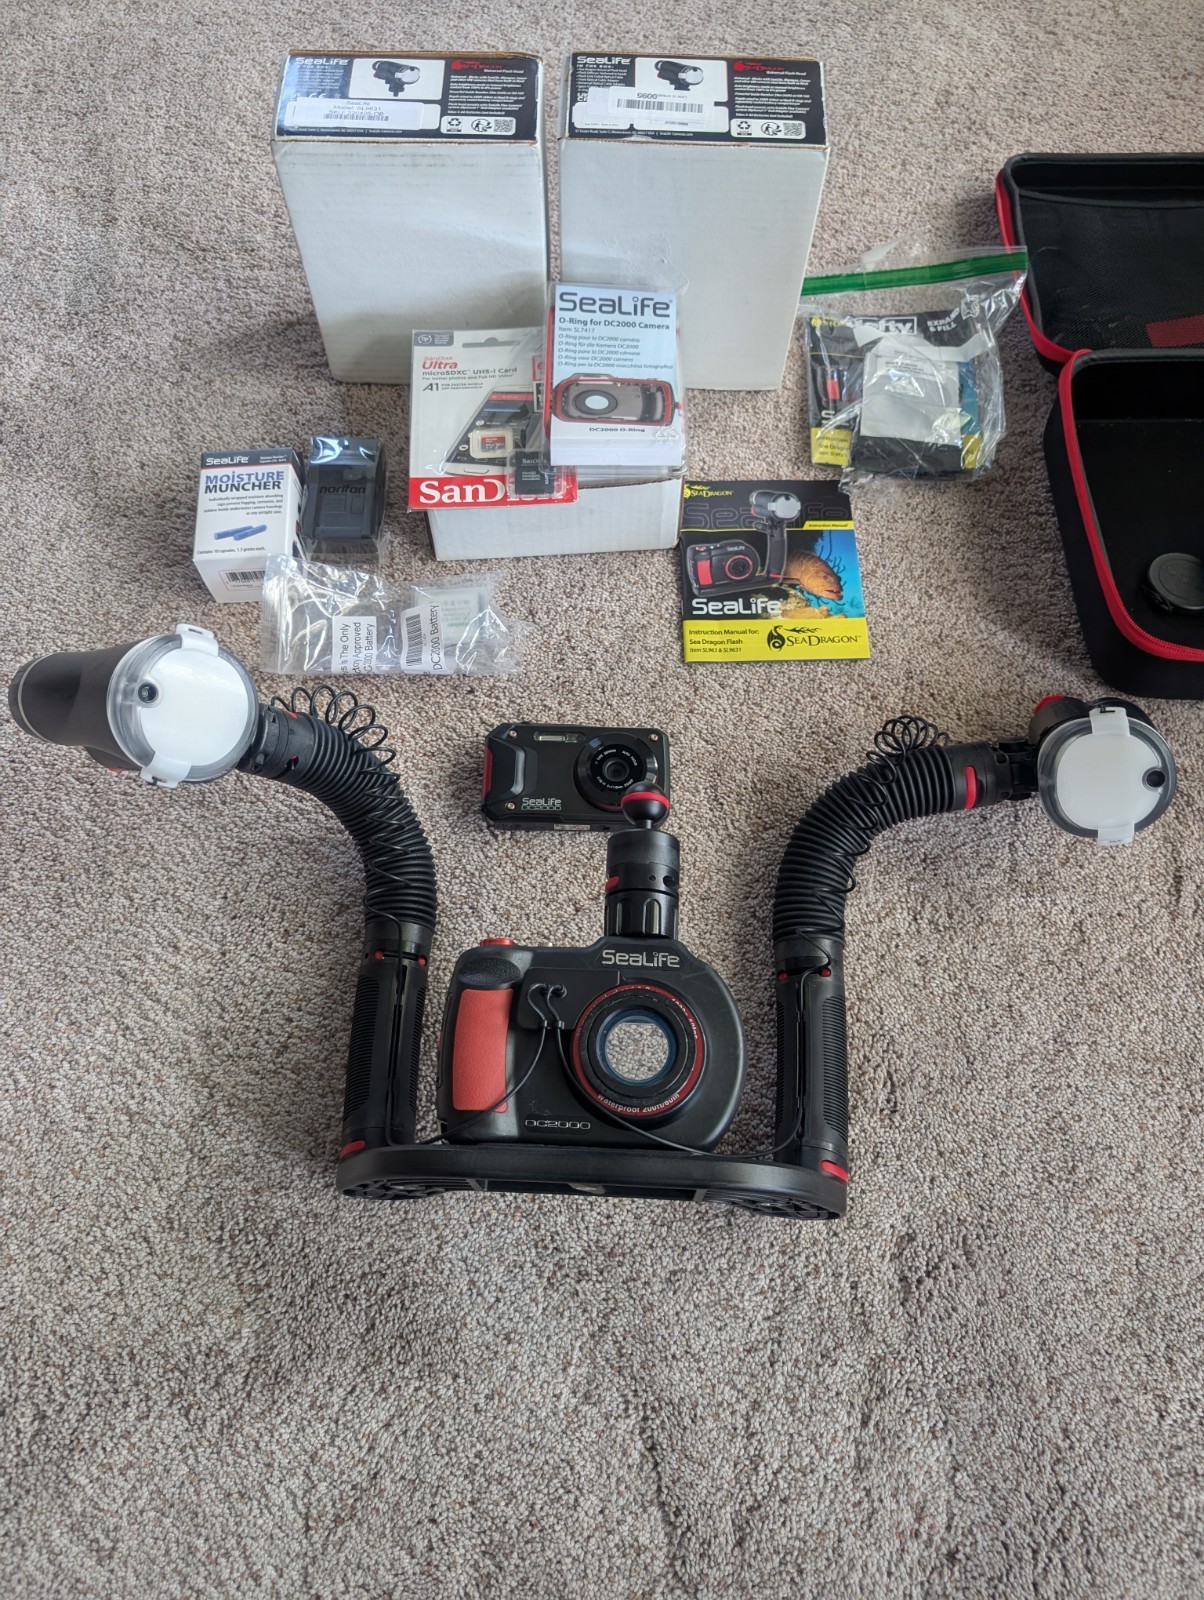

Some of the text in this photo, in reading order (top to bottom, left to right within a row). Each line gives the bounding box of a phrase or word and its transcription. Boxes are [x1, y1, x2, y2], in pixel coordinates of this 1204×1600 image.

[295, 57, 349, 65] SeaLife
[576, 56, 630, 65] SeaLife
[558, 292, 670, 318] SeaLife
[559, 317, 588, 326] O-Ring
[604, 320, 636, 328] DC2000
[638, 322, 670, 330] Camera
[422, 360, 458, 369] Ultra
[422, 382, 439, 391] A1
[206, 456, 248, 466] SeaLife
[204, 481, 281, 494] MUNCHER
[692, 598, 782, 615] SeaLife
[340, 624, 350, 642] Only
[365, 624, 375, 651] Battery
[429, 605, 443, 671] DC2000 Battery
[353, 622, 363, 658] Approved
[340, 644, 348, 659] The
[522, 798, 562, 806] SeaLife
[602, 950, 680, 968] SeaLife
[525, 1119, 591, 1130] DC2000
